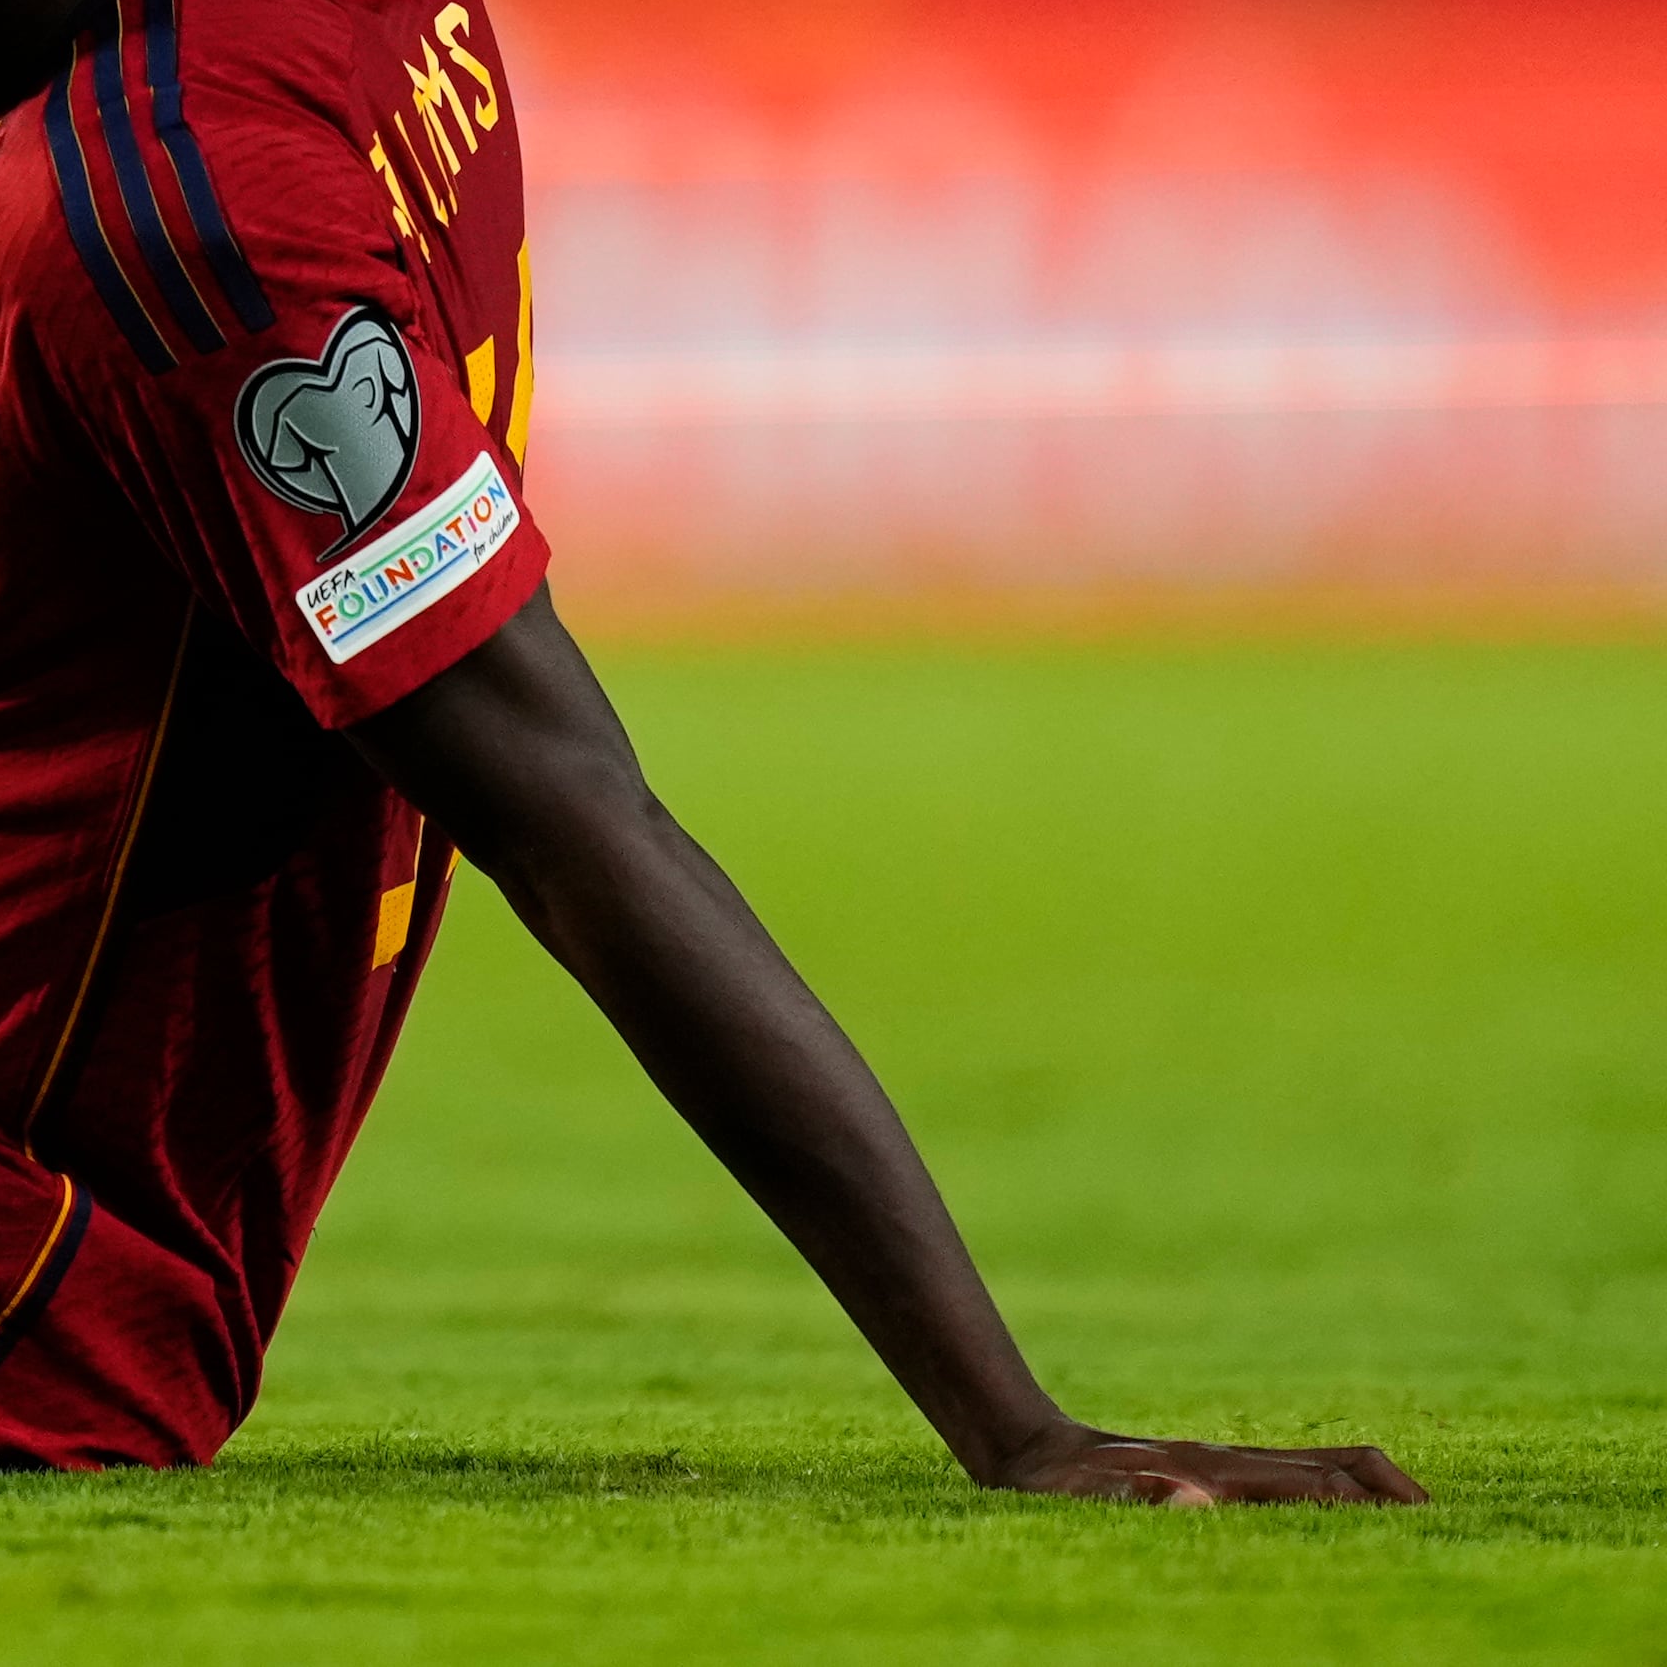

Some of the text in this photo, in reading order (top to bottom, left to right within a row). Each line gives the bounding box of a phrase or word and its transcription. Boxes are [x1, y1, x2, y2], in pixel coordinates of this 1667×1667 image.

[473, 510, 514, 564] for children
[307, 569, 356, 609] UEFA
